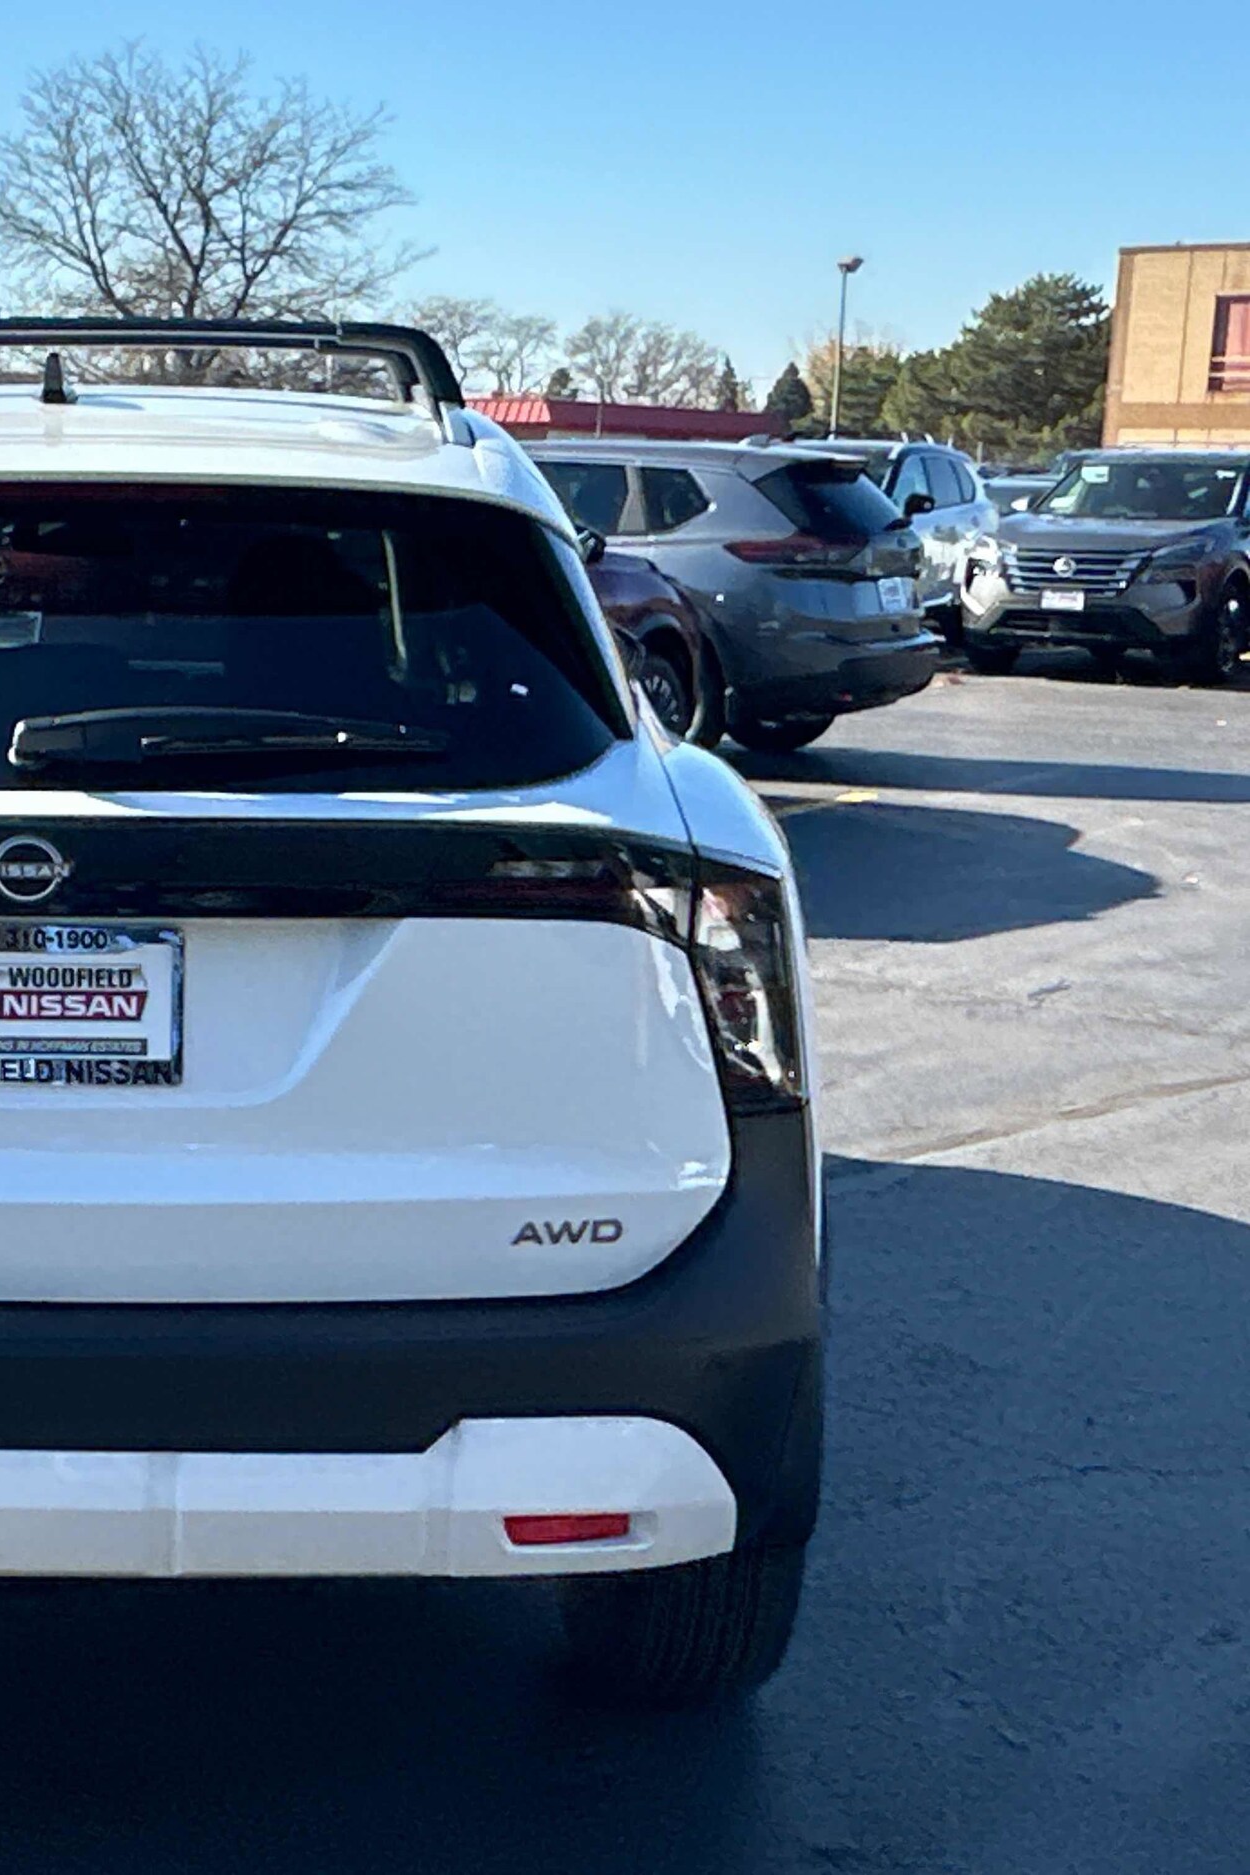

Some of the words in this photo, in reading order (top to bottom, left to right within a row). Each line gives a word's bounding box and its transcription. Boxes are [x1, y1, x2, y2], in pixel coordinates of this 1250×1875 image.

[9, 966, 132, 988] WOODFIELD
[3, 995, 138, 1017] NISSAN
[65, 1059, 172, 1084] NISSAN
[510, 1218, 623, 1245] AWD
